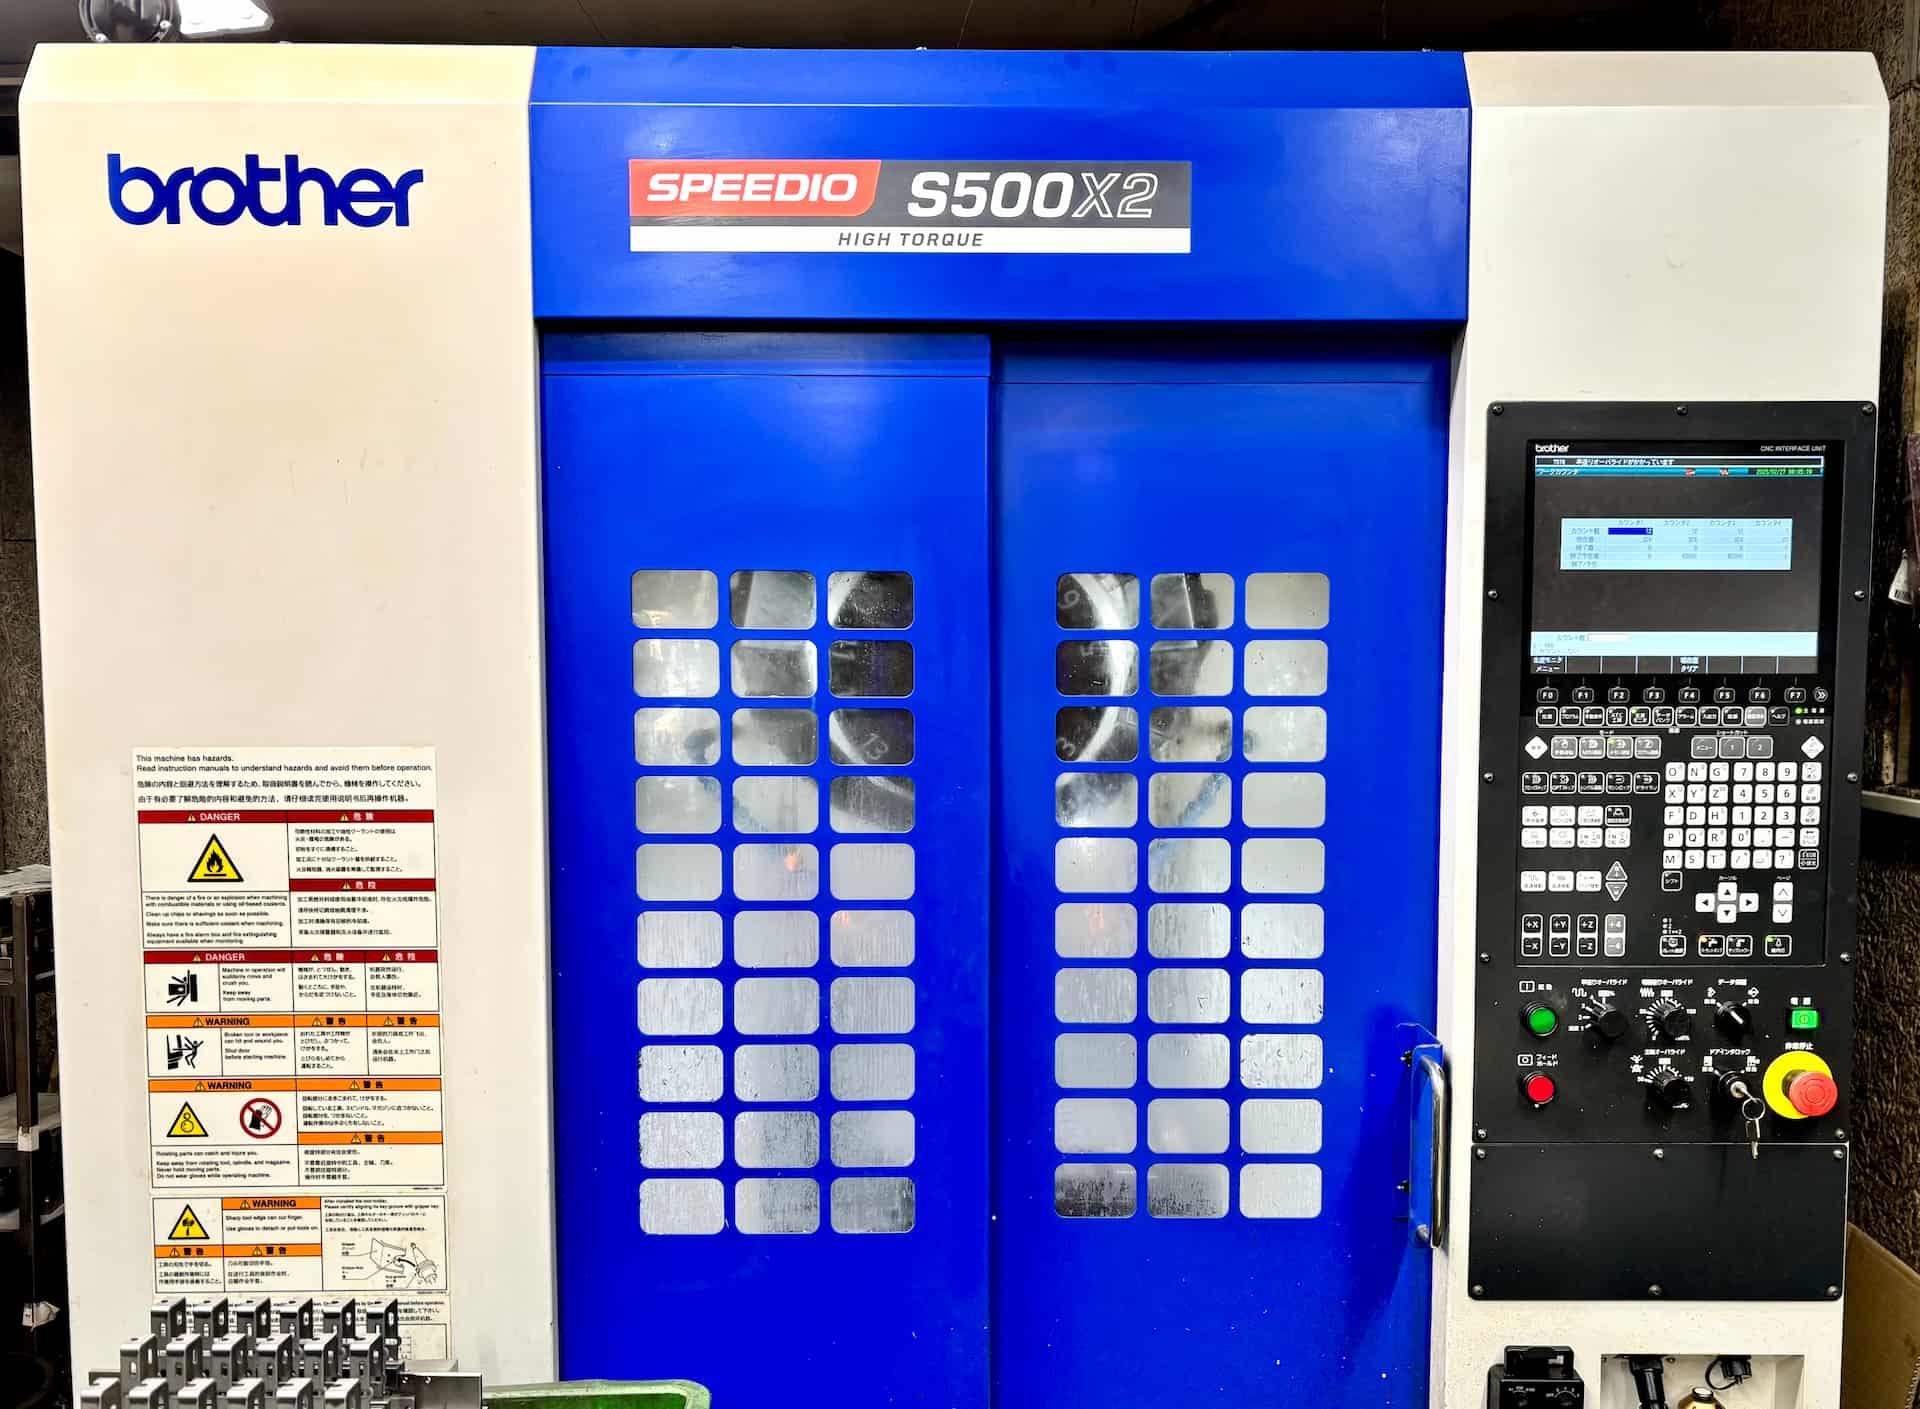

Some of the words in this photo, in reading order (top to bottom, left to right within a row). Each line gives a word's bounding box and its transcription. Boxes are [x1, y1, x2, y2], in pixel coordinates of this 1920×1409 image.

[107, 153, 423, 226] brother
[647, 172, 857, 202] SPEEDIO
[907, 172, 1159, 218] S500X2
[838, 232, 891, 247] HIGH
[899, 232, 984, 247] TORQUE
[1536, 444, 1569, 452] brother
[153, 754, 185, 762] machine
[202, 754, 235, 762] hazards.
[240, 764, 282, 772] understand
[371, 763, 395, 771] before
[396, 764, 433, 772] operation.
[1669, 768, 1676, 777] O
[1690, 768, 1698, 777] N
[1713, 768, 1720, 777] G
[1741, 768, 1746, 777] 7
[1762, 768, 1768, 777] 8
[1784, 768, 1790, 777] 9
[1669, 790, 1676, 798] X
[1690, 790, 1697, 798] Y
[1713, 790, 1719, 798] Z
[1739, 790, 1746, 798] 4
[1762, 790, 1767, 798] 5
[1784, 790, 1790, 798] 6
[200, 812, 240, 821] DANGER
[1669, 812, 1674, 820] F
[1690, 812, 1697, 820] D
[1712, 812, 1719, 820] H
[1740, 812, 1744, 820] 1
[1761, 812, 1767, 820] 2
[1784, 812, 1789, 820] 3
[1668, 833, 1674, 842] P
[1689, 833, 1697, 843] Q
[1712, 833, 1718, 842] R
[1738, 833, 1744, 842] 0
[205, 953, 245, 961] DANGER
[205, 1017, 250, 1026] WARNING
[207, 1081, 252, 1090] WARNING
